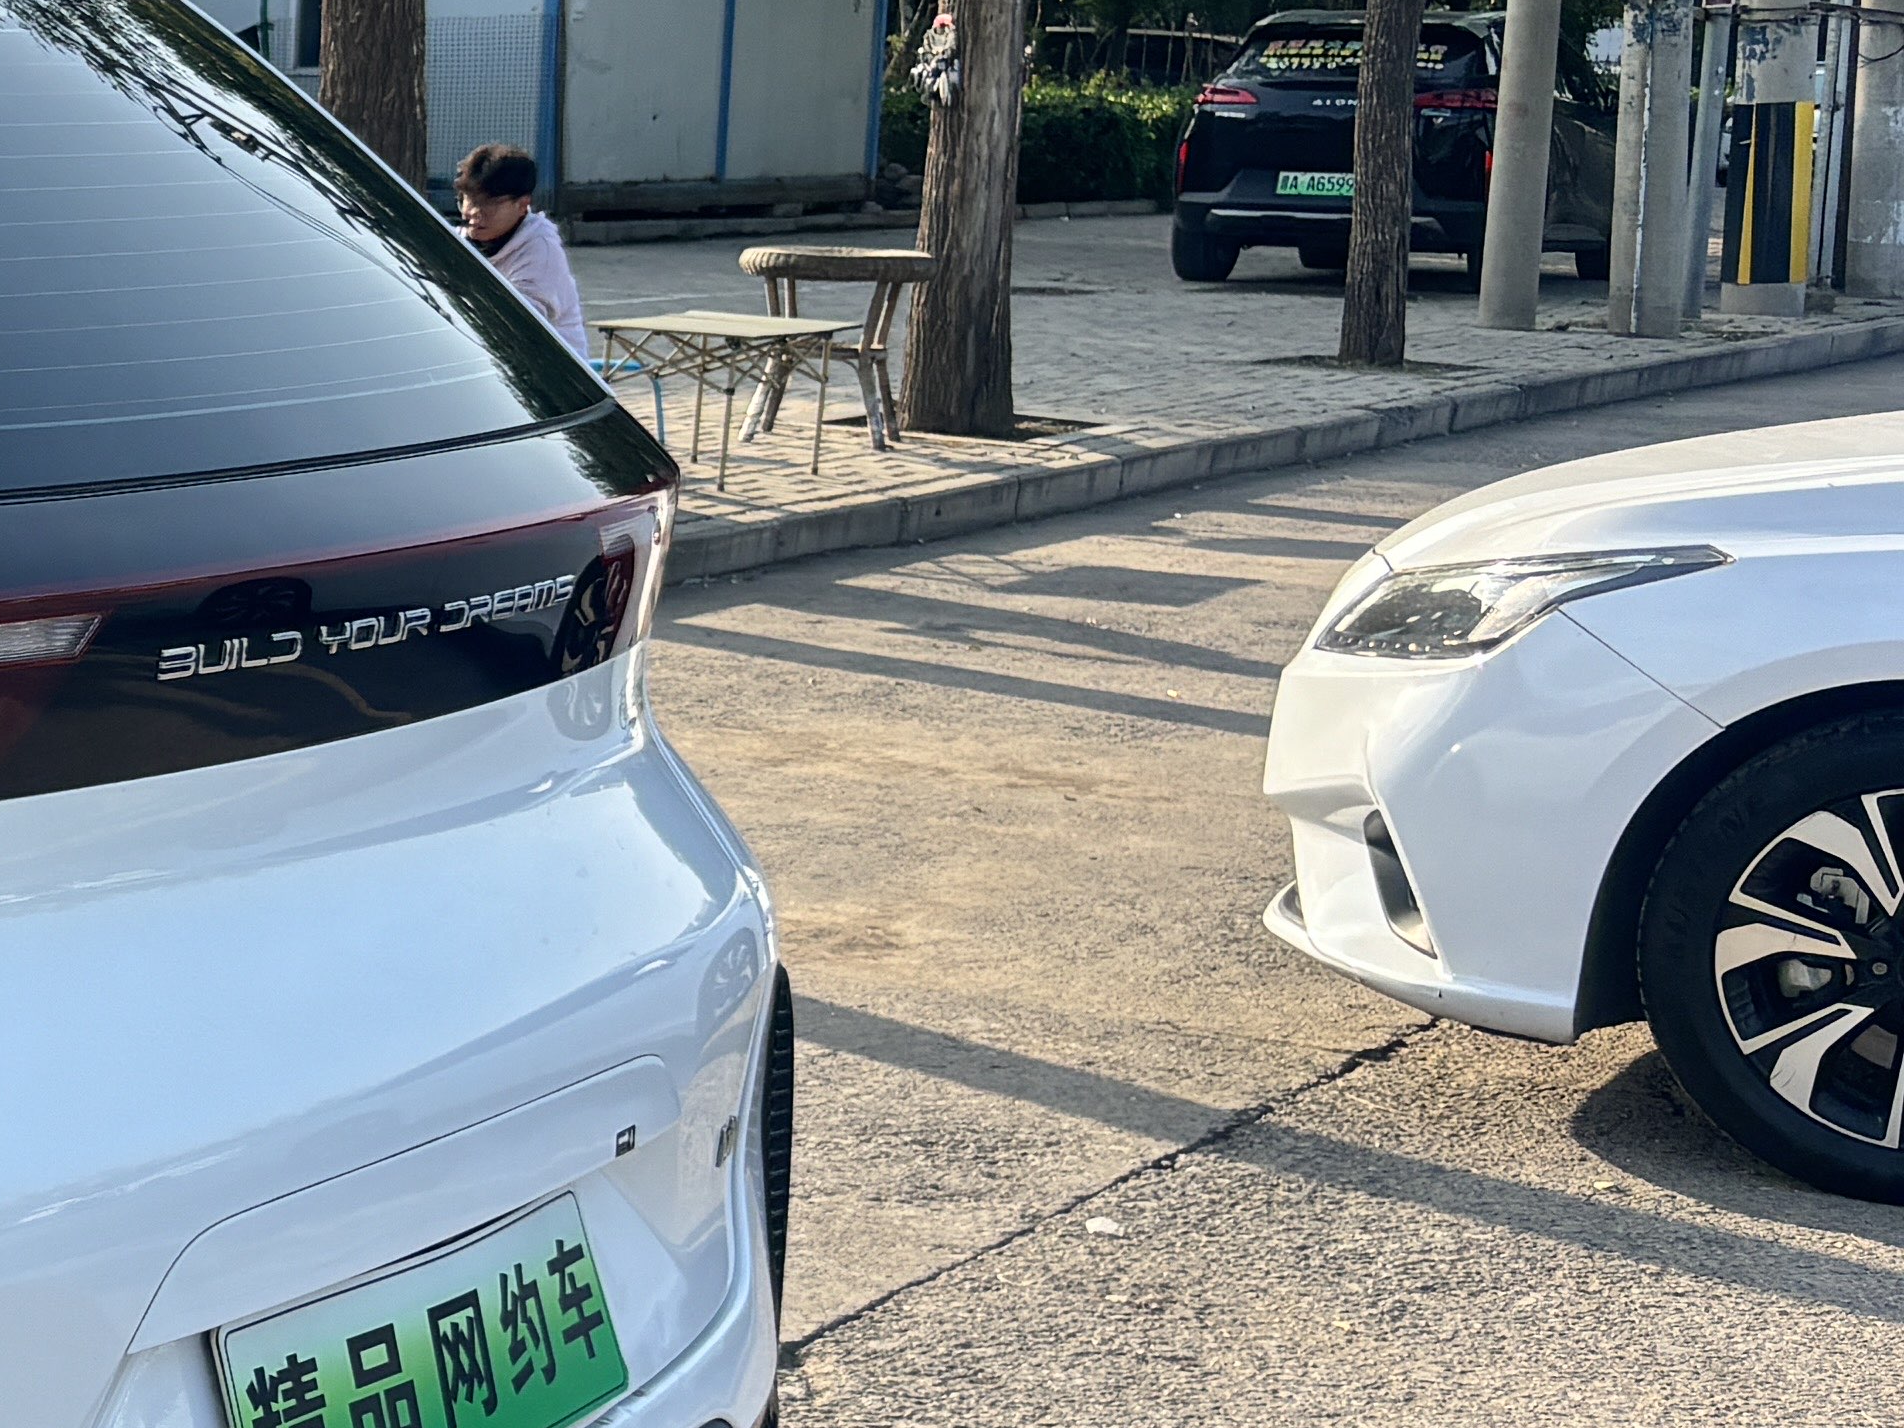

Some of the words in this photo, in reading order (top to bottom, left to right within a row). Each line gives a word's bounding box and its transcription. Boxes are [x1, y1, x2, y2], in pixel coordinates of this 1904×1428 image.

[1280, 175, 1299, 192] A
[156, 630, 302, 681] BUILD
[320, 606, 432, 653] YOUR
[439, 573, 576, 634] DREAMS
